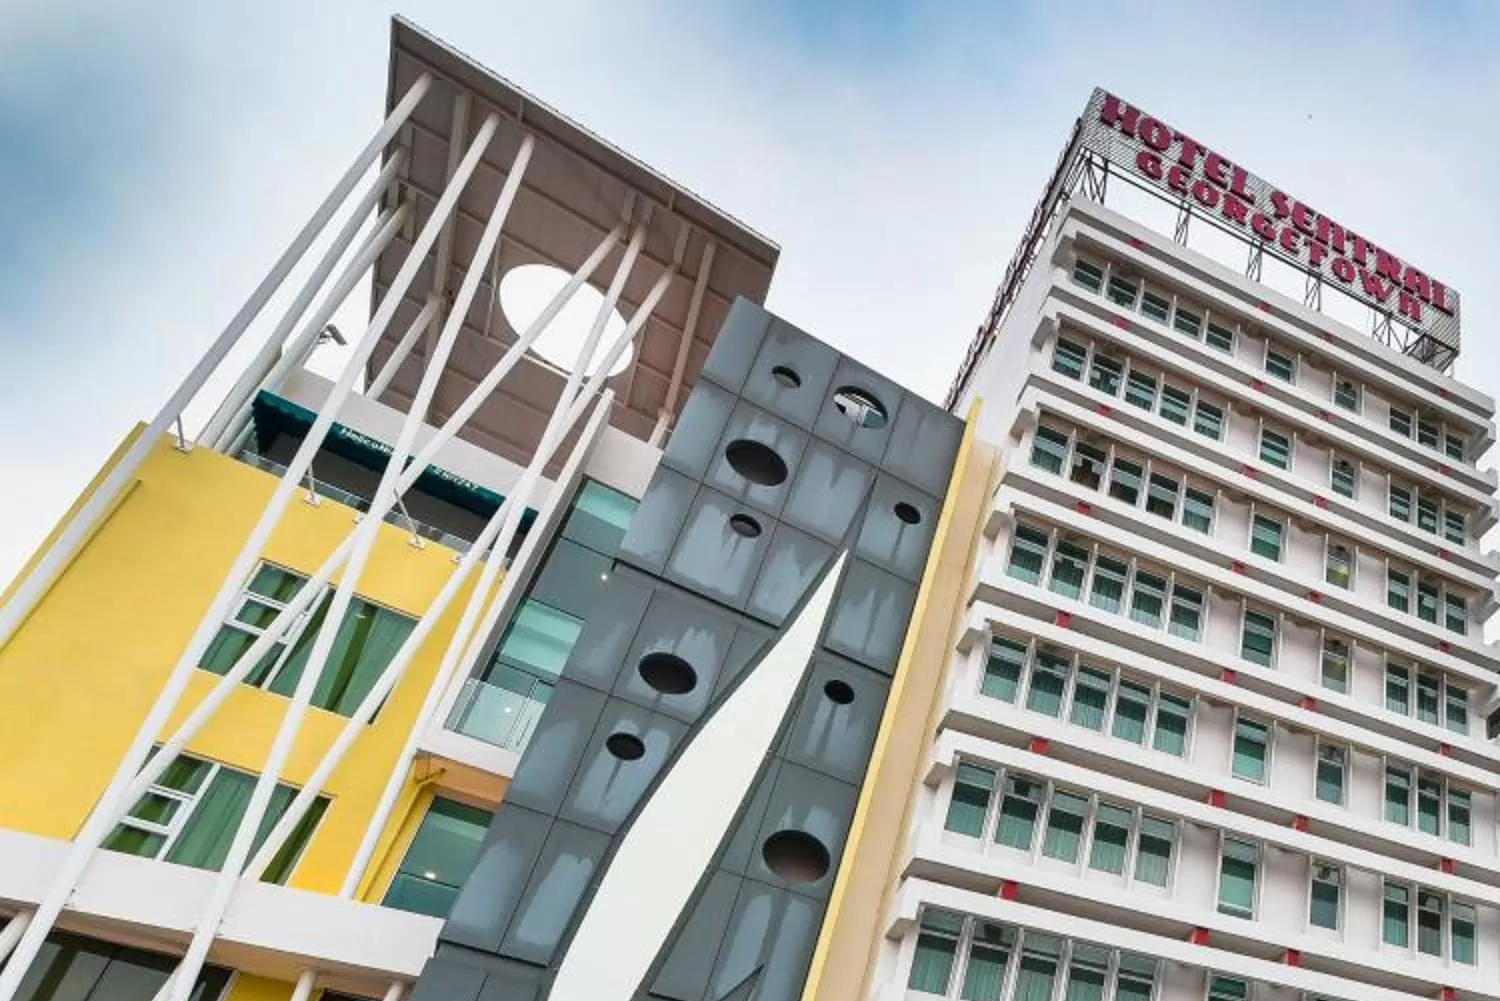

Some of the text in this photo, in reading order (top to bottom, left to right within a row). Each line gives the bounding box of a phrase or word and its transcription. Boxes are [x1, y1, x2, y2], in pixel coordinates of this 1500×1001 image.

[1100, 93, 1455, 316] HOTEL SENTRAL
[1136, 149, 1423, 323] GEORGETOWN
